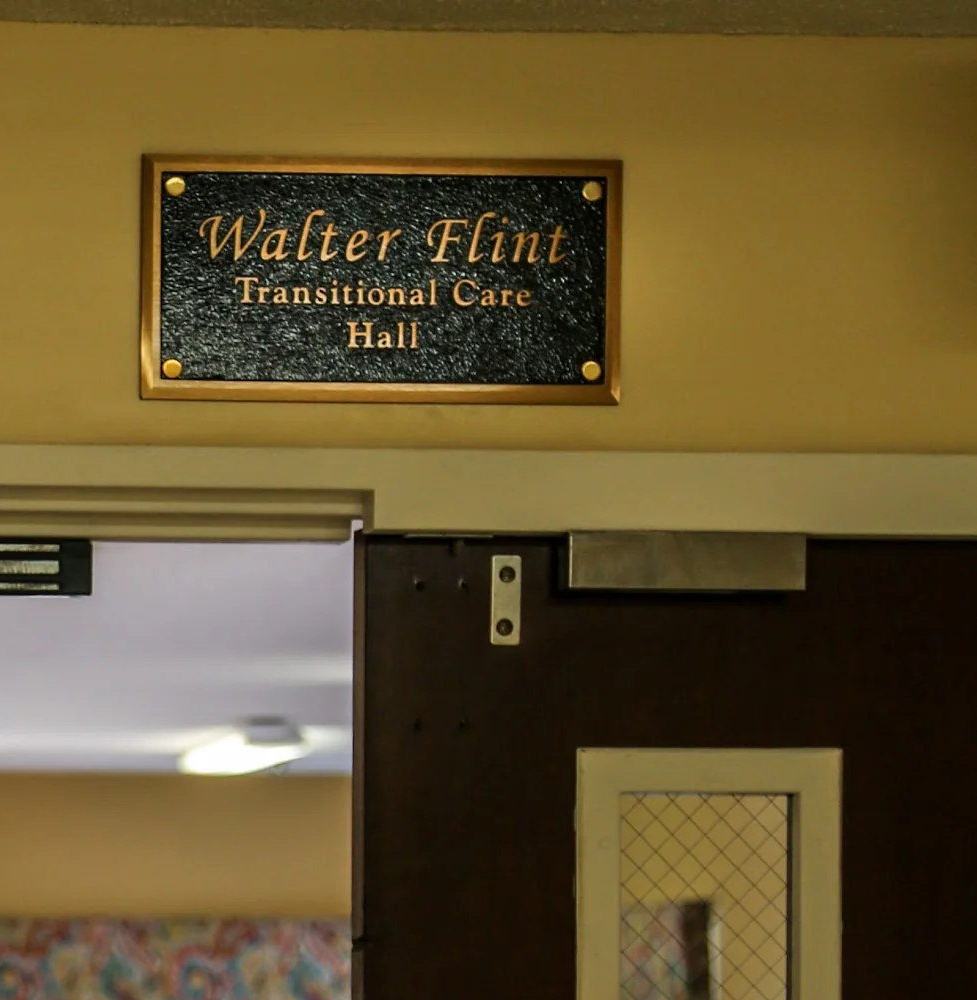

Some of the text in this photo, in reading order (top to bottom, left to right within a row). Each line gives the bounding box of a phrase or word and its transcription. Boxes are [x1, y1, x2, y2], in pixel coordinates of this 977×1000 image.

[199, 209, 569, 264] Walter Flint
[234, 276, 532, 307] Transitional Care
[346, 321, 420, 349] Hall
